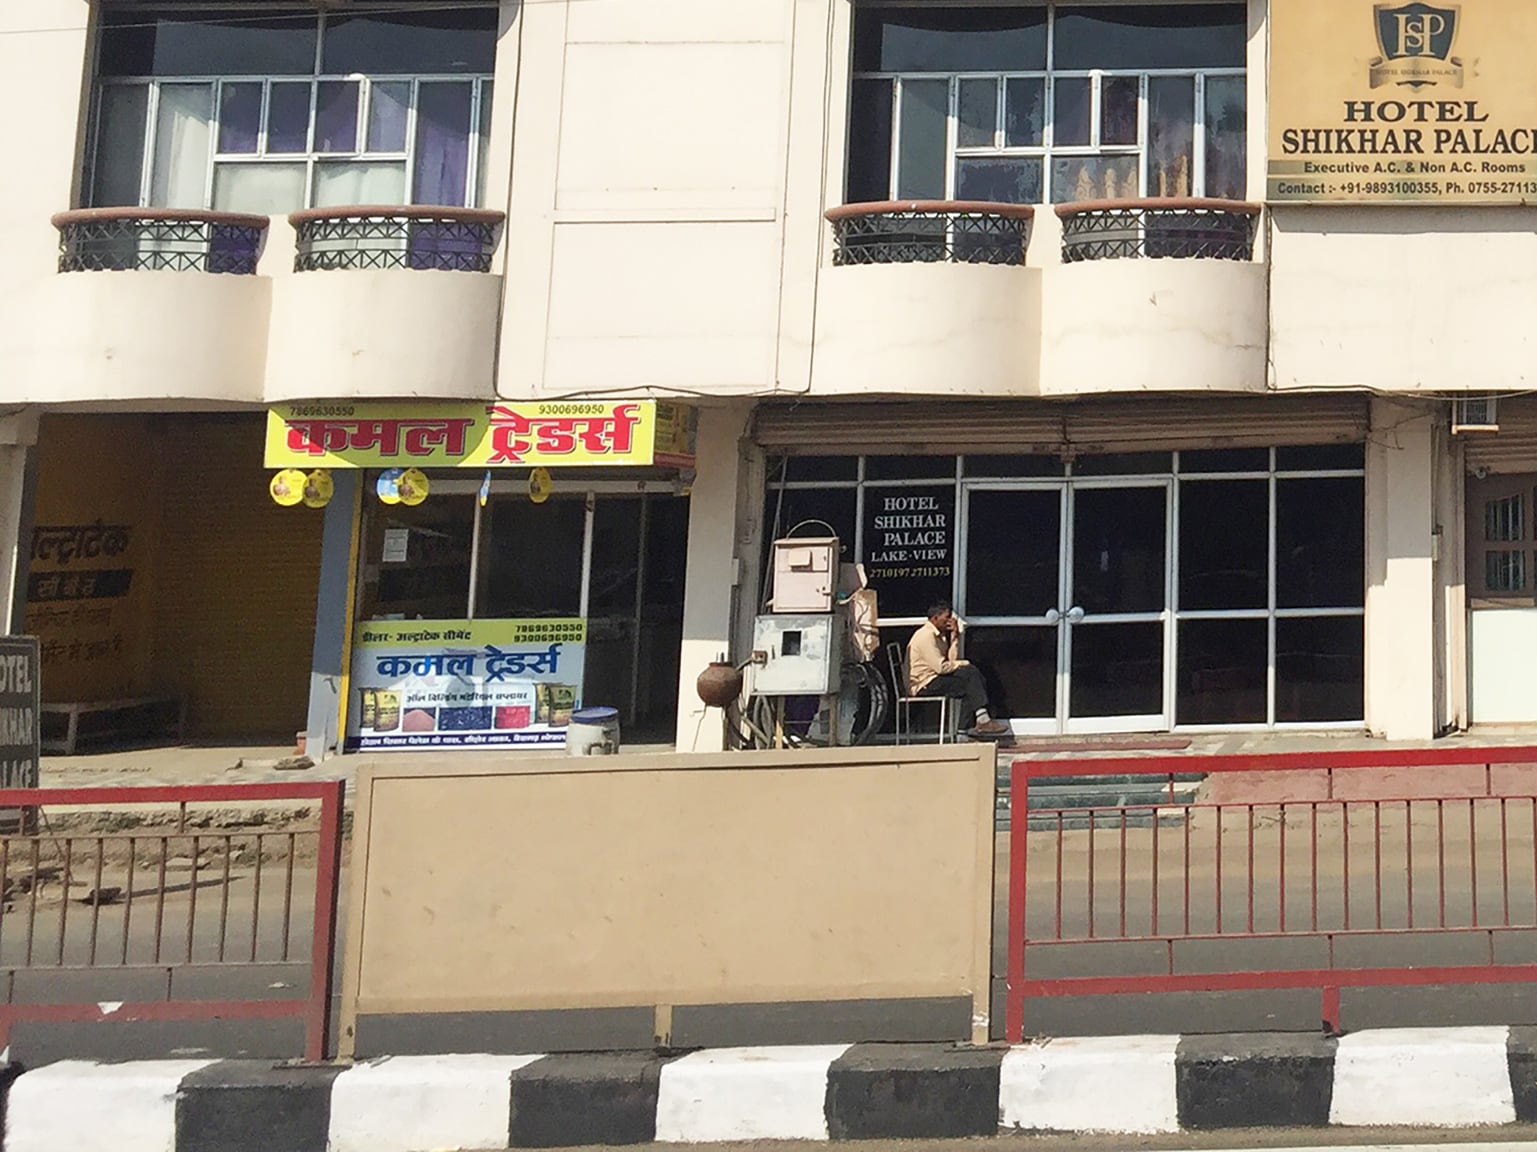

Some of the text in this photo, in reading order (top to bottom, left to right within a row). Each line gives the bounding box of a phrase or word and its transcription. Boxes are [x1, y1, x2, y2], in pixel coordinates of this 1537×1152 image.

[1343, 100, 1489, 123] HOTEL
[1282, 128, 1425, 155] SHIKHAR
[1304, 162, 1526, 174] Executive A.C. & Non A.C. Rooms
[1278, 182, 1326, 195] Contact
[1339, 181, 1442, 196] +91-9893100355,
[1445, 181, 1464, 194] Ph.
[289, 405, 356, 417] 7869630550
[538, 403, 605, 415] 9300696950
[284, 403, 644, 464] कमल ट्रेडर्स
[883, 496, 939, 511] HOTEL
[874, 514, 946, 529] SHIKHAR
[883, 531, 946, 547] PALACE
[376, 643, 563, 683] कमल ट्रेडर्स
[0, 655, 32, 694] OTEL
